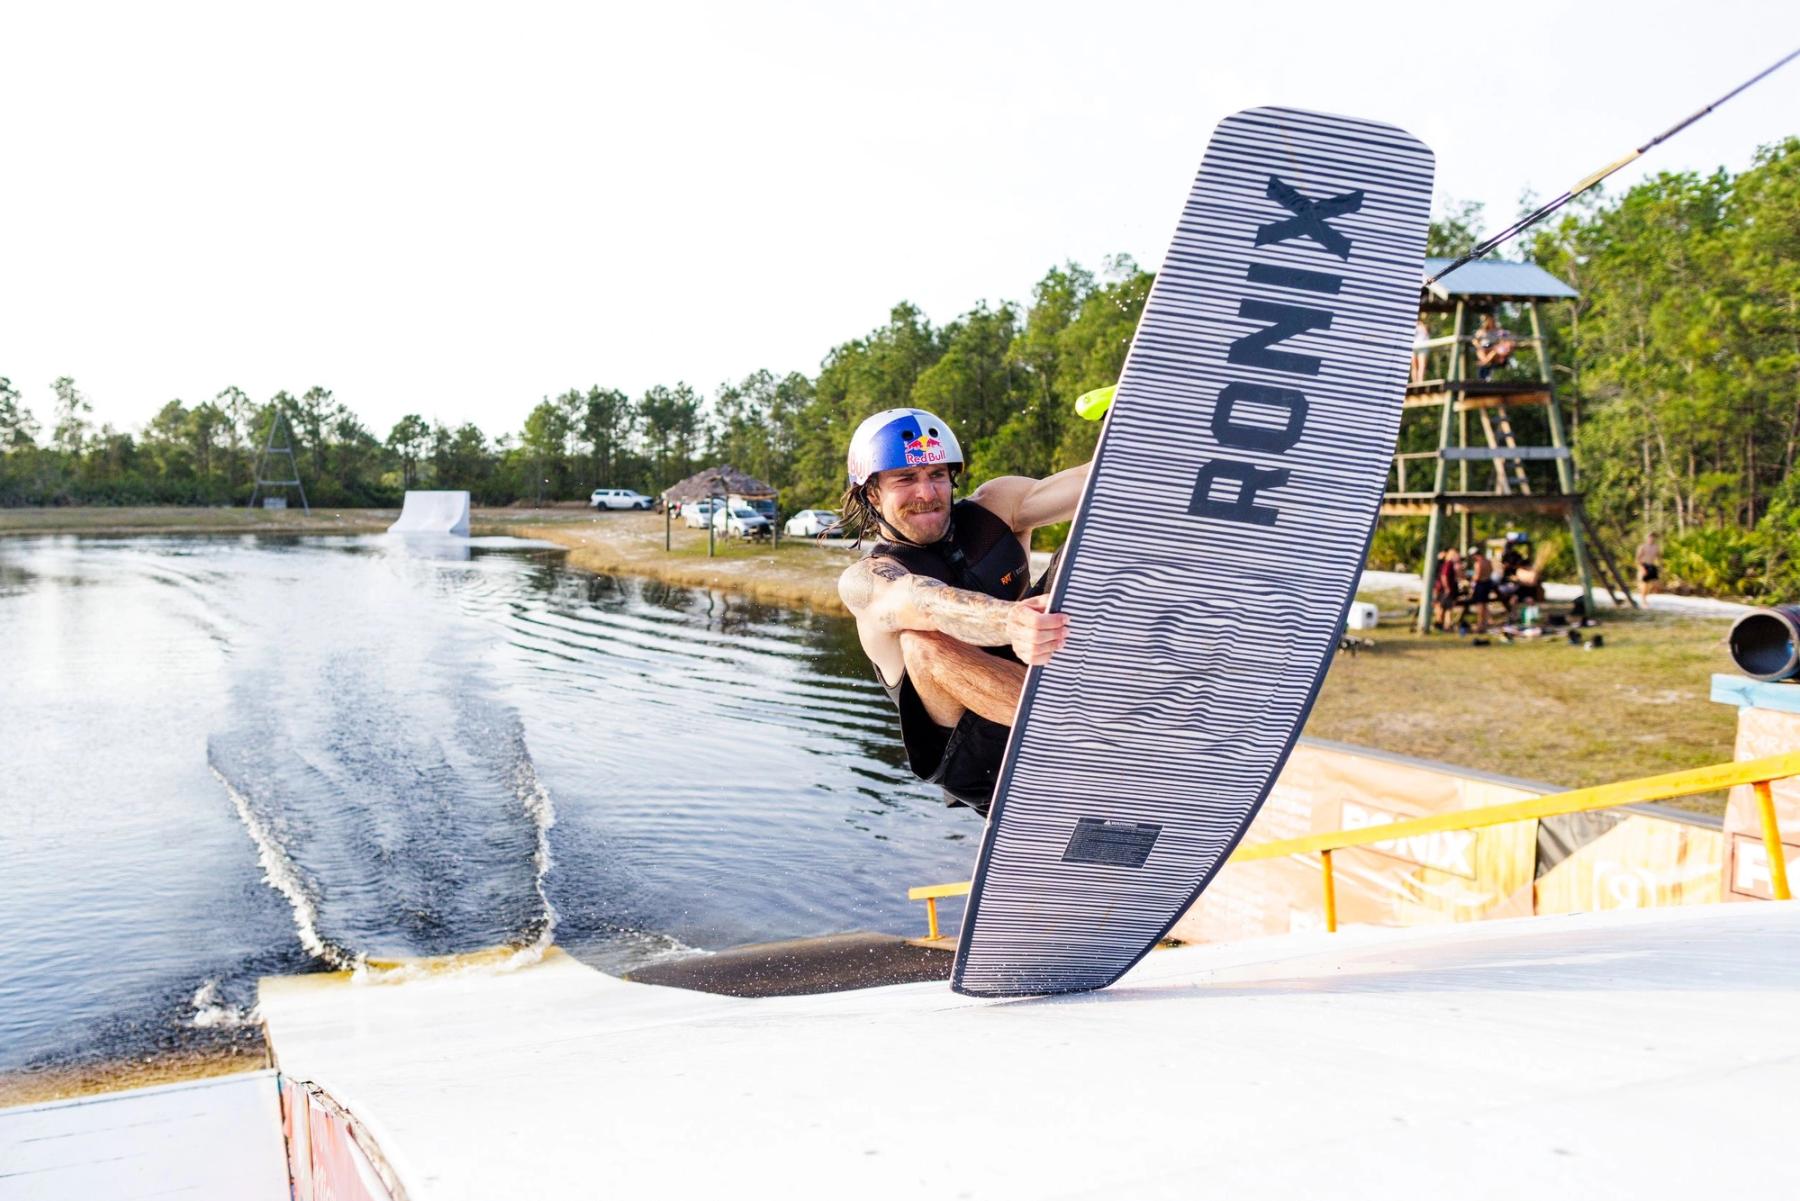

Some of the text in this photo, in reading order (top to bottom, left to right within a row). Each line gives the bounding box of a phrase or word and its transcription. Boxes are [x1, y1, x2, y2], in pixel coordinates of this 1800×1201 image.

[1188, 175, 1364, 526] RONIX
[906, 450, 946, 464] Red Bull
